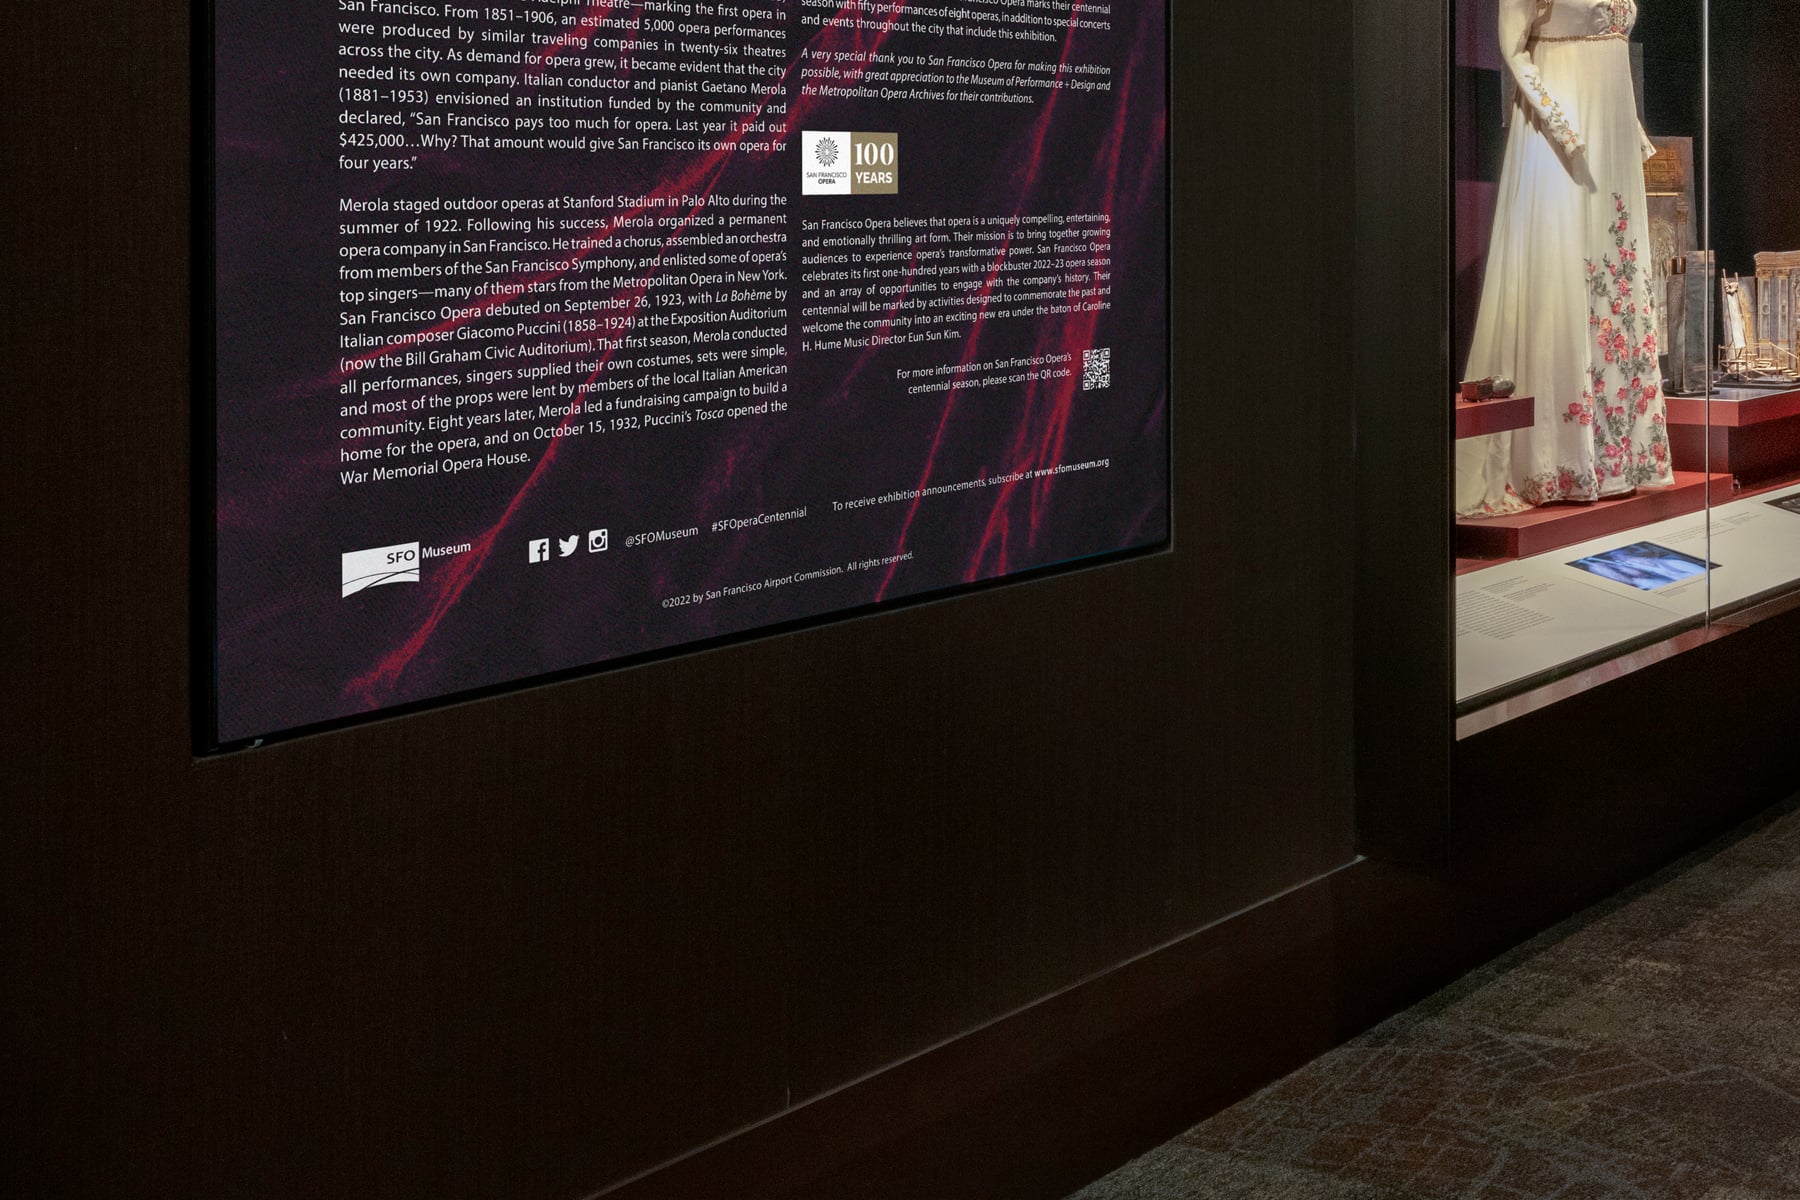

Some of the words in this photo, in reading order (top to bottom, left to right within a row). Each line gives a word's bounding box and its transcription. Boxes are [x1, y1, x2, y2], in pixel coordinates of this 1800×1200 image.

[801, 83, 817, 96] the
[818, 84, 879, 99] Metropolitan
[880, 86, 908, 101] Opera
[908, 88, 945, 101] Archives
[945, 88, 959, 101] for
[959, 90, 979, 101] their
[979, 93, 1034, 104] contributions.
[854, 142, 894, 166] 100
[855, 171, 893, 184] YEARS
[339, 197, 389, 212] Merola
[393, 196, 440, 214] staged
[443, 196, 498, 210] outdoor
[501, 199, 544, 212] operas
[547, 196, 560, 209] at
[562, 194, 614, 209] Stanford
[617, 194, 665, 208] Stadium
[667, 194, 679, 207] in
[681, 193, 705, 207] Palo
[707, 193, 730, 206] Alto
[732, 193, 767, 208] during
[769, 193, 787, 206] the
[801, 219, 819, 231] San
[821, 218, 863, 230] Francisco
[864, 217, 891, 231] Opera
[892, 216, 928, 228] believes
[929, 215, 946, 227] that
[947, 217, 971, 228] opera
[972, 215, 979, 225] is
[980, 217, 986, 225] a
[987, 214, 1021, 227] uniquely
[1021, 213, 1065, 226] compelling,
[1065, 212, 1111, 224] entertaining,
[802, 340, 812, 352] H.
[814, 339, 842, 350] Hume
[843, 336, 870, 348] Music
[871, 334, 907, 346] Director
[908, 331, 924, 343] Eun
[925, 330, 942, 341] Sun
[943, 329, 962, 339] Kim.
[896, 368, 911, 379] For
[912, 367, 934, 378] more
[935, 361, 982, 376] information
[982, 361, 993, 370] on
[994, 358, 1009, 369] San
[1010, 355, 1045, 367] Francisco
[907, 379, 951, 395] centennial
[952, 378, 981, 390] season,
[982, 375, 1008, 388] please
[1008, 373, 1026, 383] scan
[1026, 370, 1039, 381] the
[1039, 368, 1052, 380] QR
[1052, 366, 1072, 378] code.
[340, 469, 369, 485] War
[372, 459, 438, 481] Memorial
[441, 457, 483, 474] Opera
[486, 452, 530, 467] House.
[831, 500, 843, 511] To
[844, 496, 876, 509] receive
[877, 489, 920, 504] exhibition
[921, 478, 987, 497] announcements,
[988, 471, 1024, 485] subscribe
[1024, 469, 1033, 479] at
[1033, 458, 1110, 478] www.sfomuseum.org
[624, 526, 699, 548] @SFOMuseum
[711, 506, 807, 532] #SFOperaCentennial
[386, 549, 416, 565] SFO
[421, 542, 471, 559] Museum
[661, 594, 691, 608] ©2022
[692, 592, 704, 604] by
[705, 590, 722, 600] San
[722, 582, 762, 596] Francisco
[763, 575, 792, 588] Airport
[793, 566, 844, 582] Commission.
[846, 560, 857, 572] All
[858, 558, 881, 571] rights
[881, 550, 914, 565] reserved.
